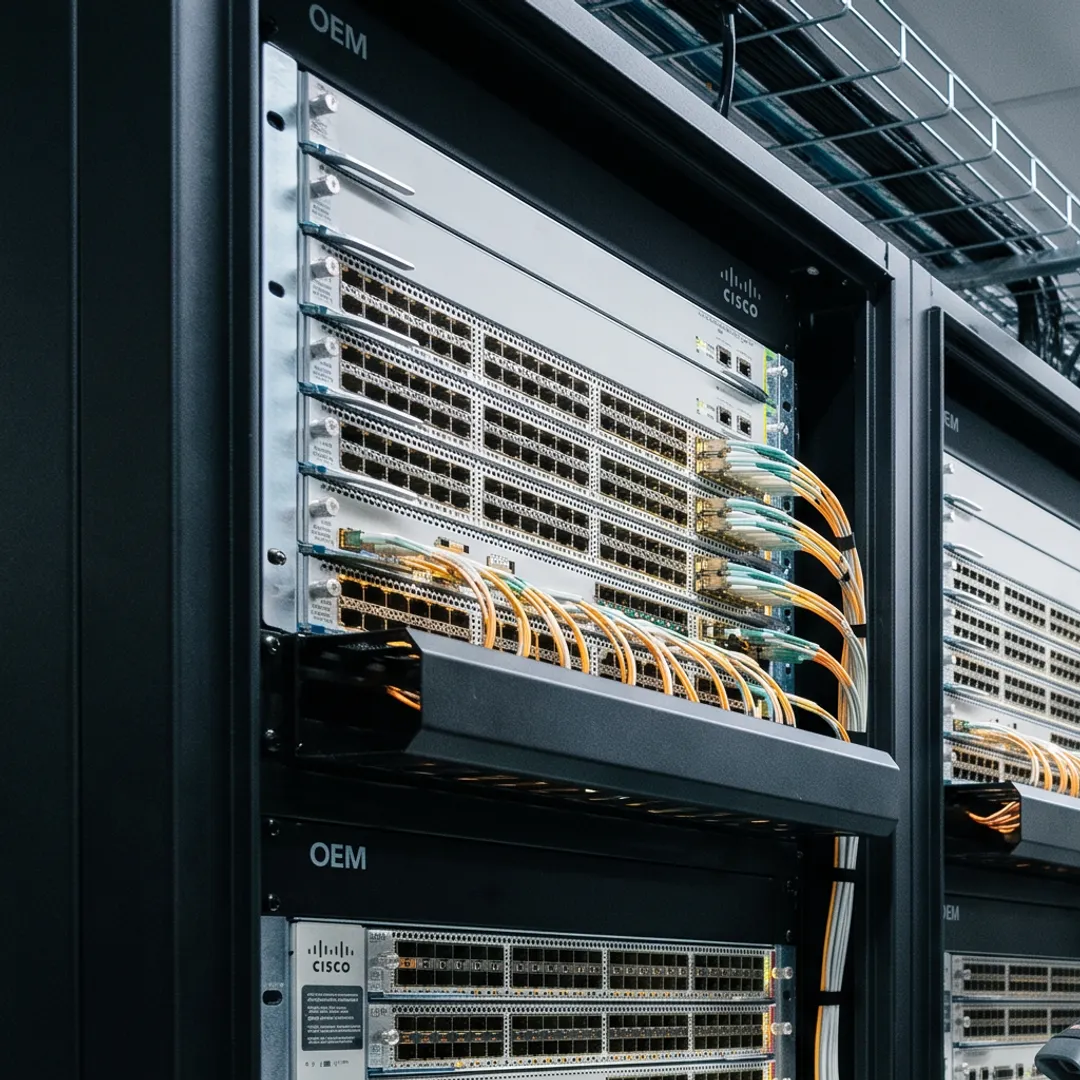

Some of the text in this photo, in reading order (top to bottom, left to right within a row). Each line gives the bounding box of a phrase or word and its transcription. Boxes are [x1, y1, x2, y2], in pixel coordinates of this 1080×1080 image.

[309, 3, 368, 60] OEM
[723, 288, 758, 318] CISCO
[944, 410, 959, 433] EM
[310, 841, 367, 870] OEM
[312, 960, 351, 973] CISCO
